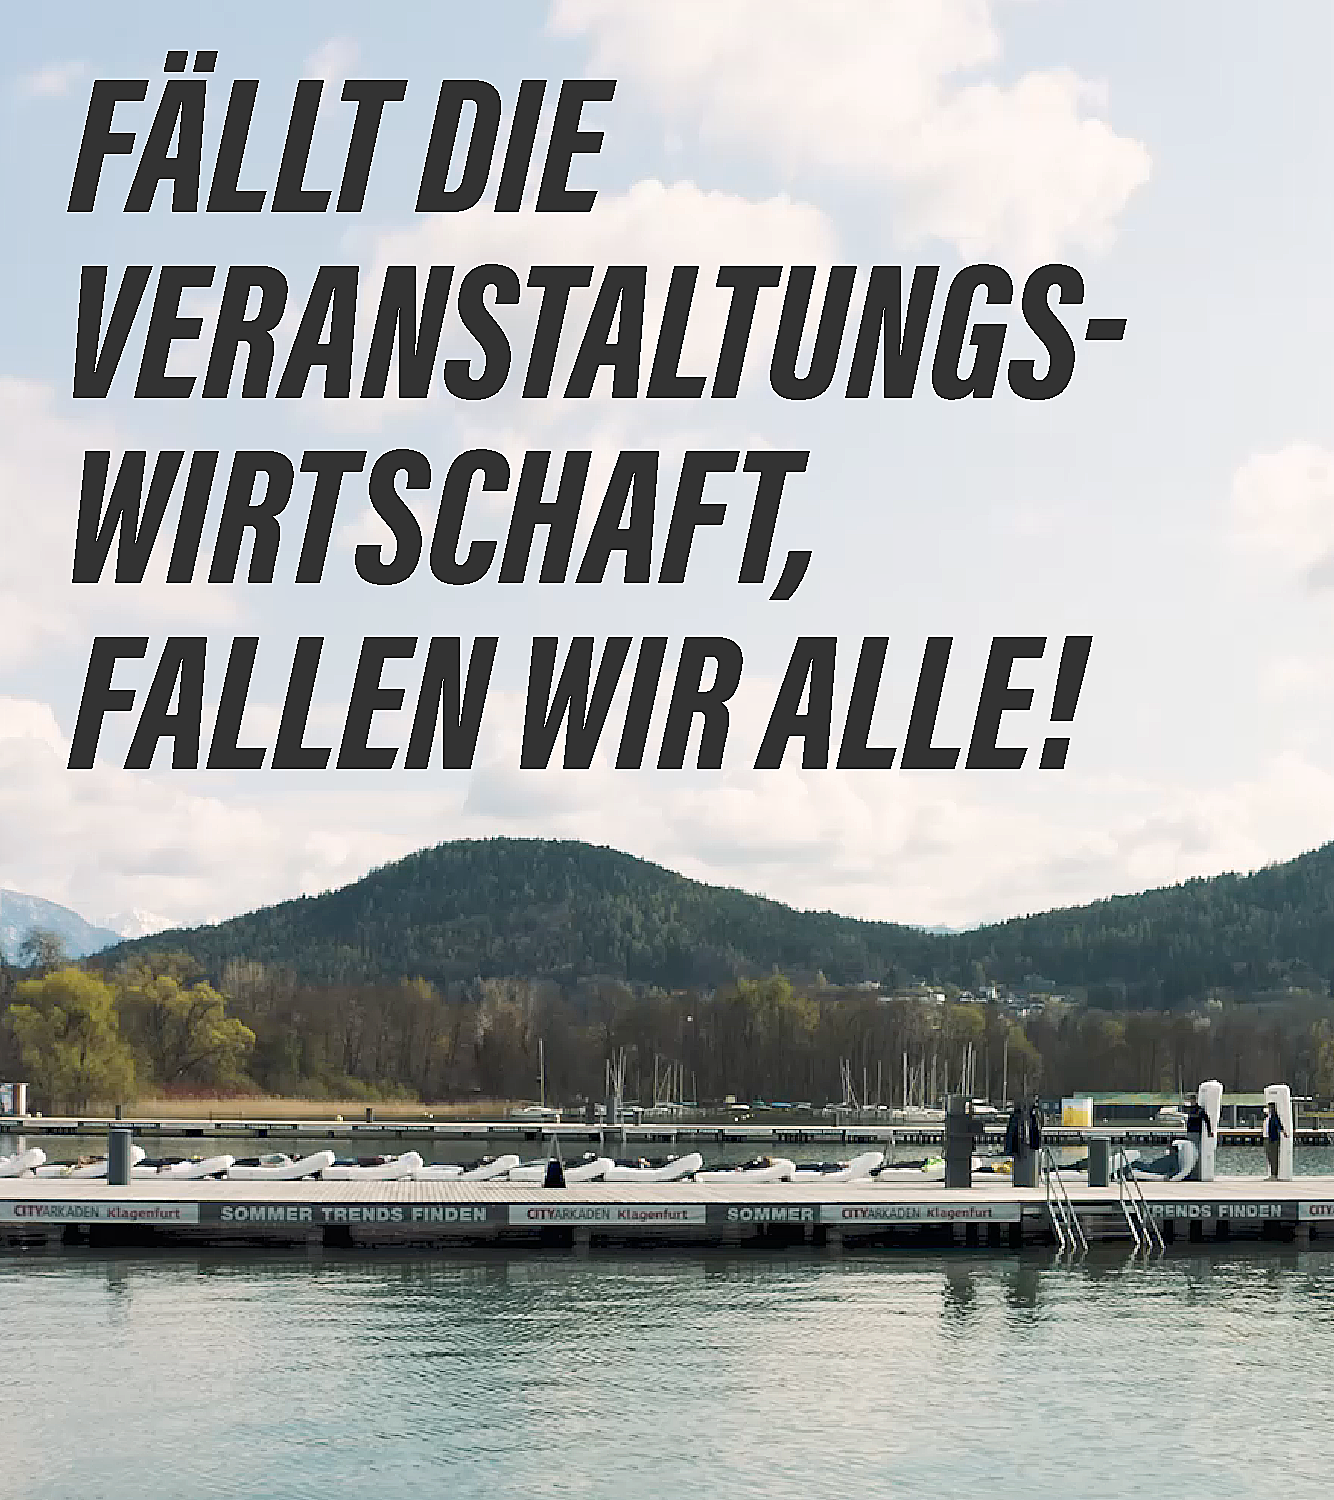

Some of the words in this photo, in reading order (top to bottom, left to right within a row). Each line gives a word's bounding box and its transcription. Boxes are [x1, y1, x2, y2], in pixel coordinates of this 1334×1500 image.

[13, 1204, 100, 1218] CITYARKADEN
[106, 1205, 181, 1220] Klagenfurt
[219, 1205, 313, 1221] SOMMER
[321, 1206, 402, 1222] TRENDS
[412, 1207, 487, 1222] FINDEN
[526, 1208, 610, 1220] CITYARKADEN
[617, 1208, 689, 1223] Klagenfurt
[726, 1206, 815, 1221] SOMMER
[841, 1207, 922, 1219] CITYARKADEN
[926, 1207, 993, 1220] Klagenfurt
[1218, 1204, 1282, 1218] FINDEN
